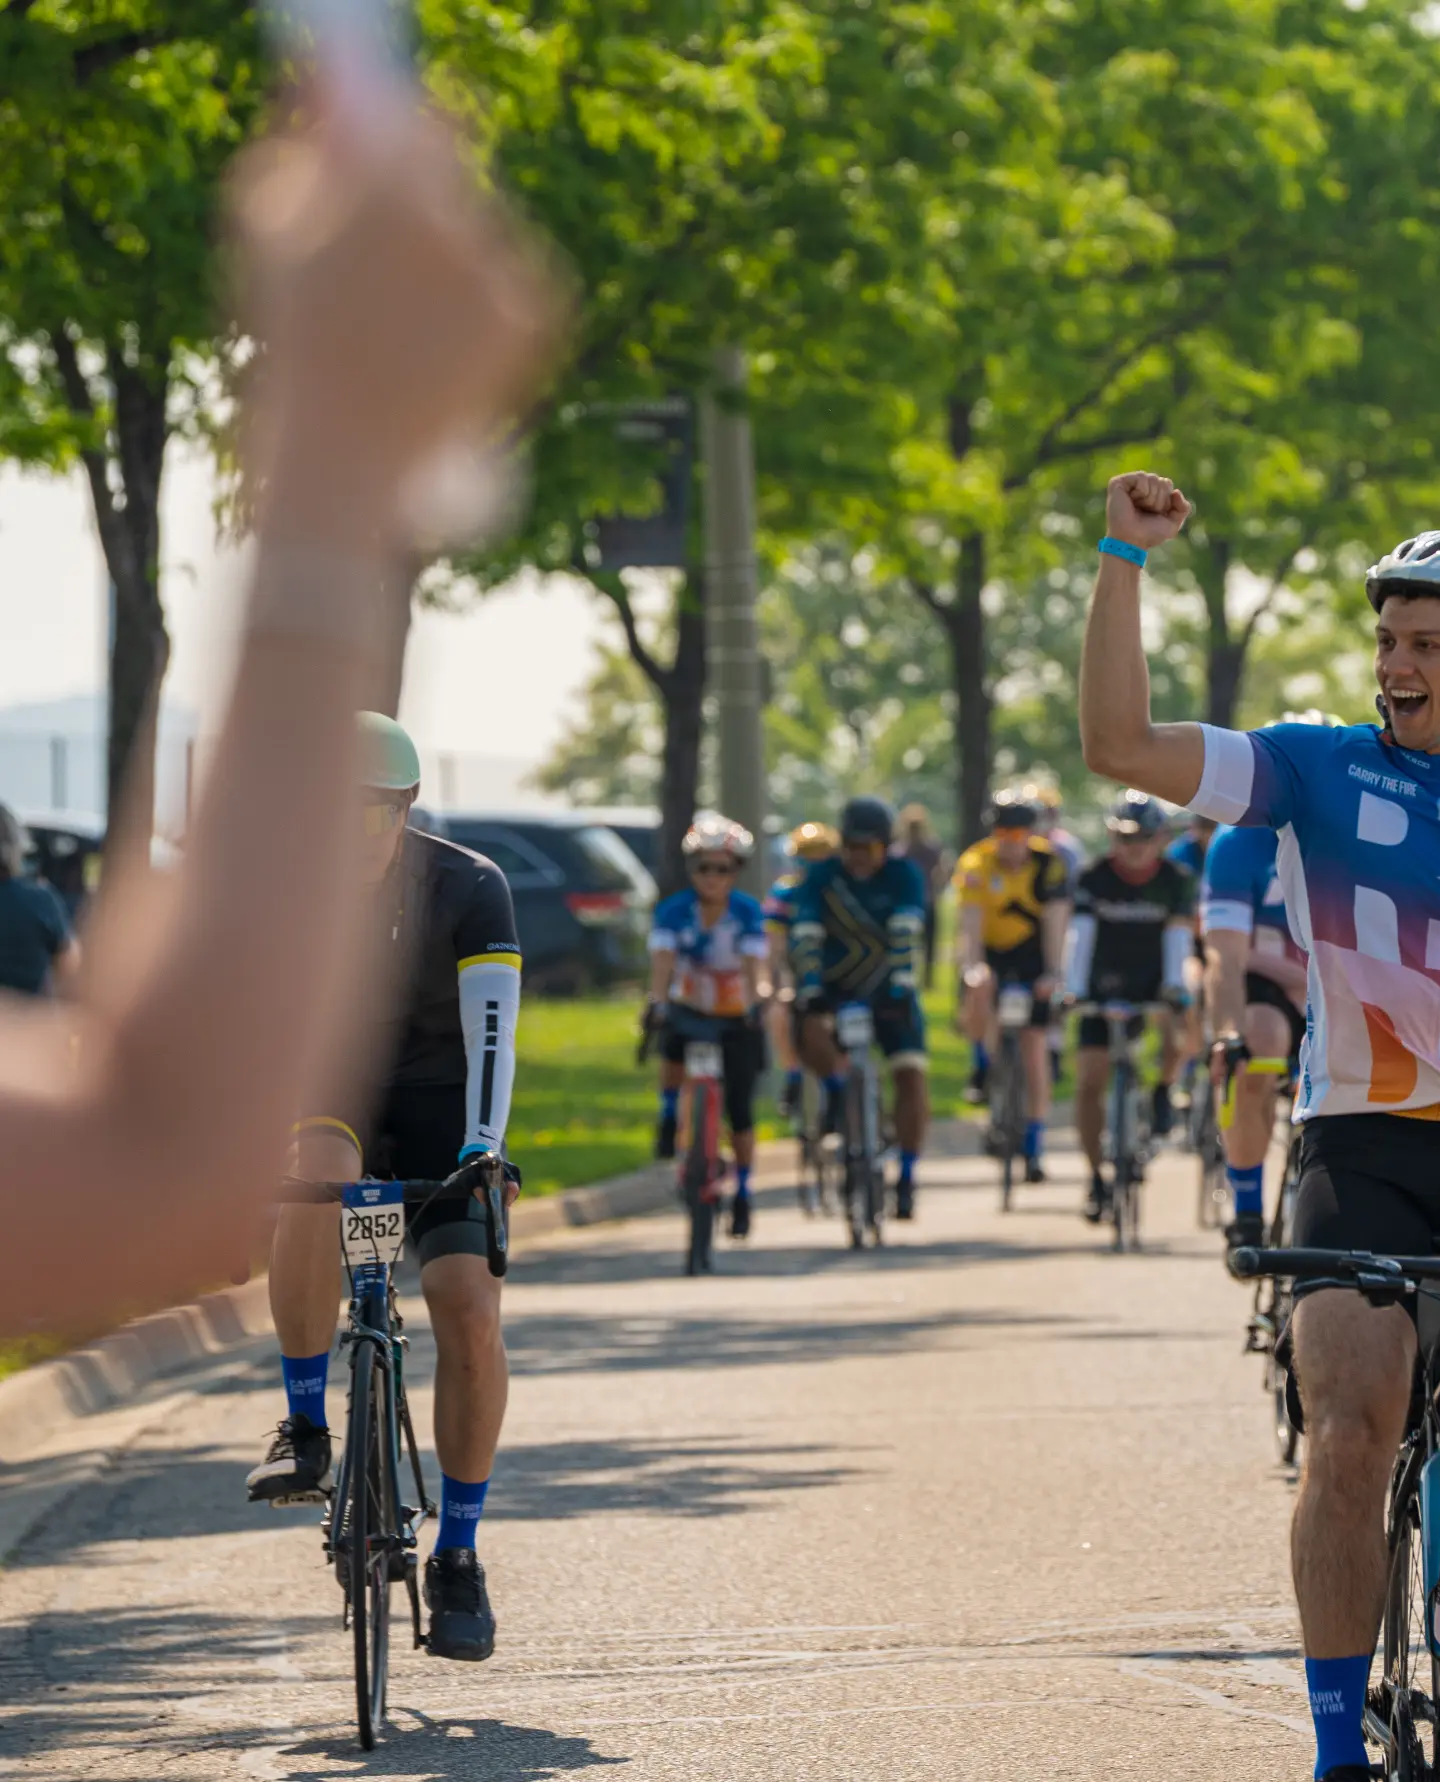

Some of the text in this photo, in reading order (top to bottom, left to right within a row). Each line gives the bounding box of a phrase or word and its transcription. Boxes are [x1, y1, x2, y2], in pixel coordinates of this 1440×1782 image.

[1348, 764, 1417, 797] CARRY THE FIRE
[347, 1213, 399, 1241] 2852
[1312, 1690, 1342, 1704] ARRY
